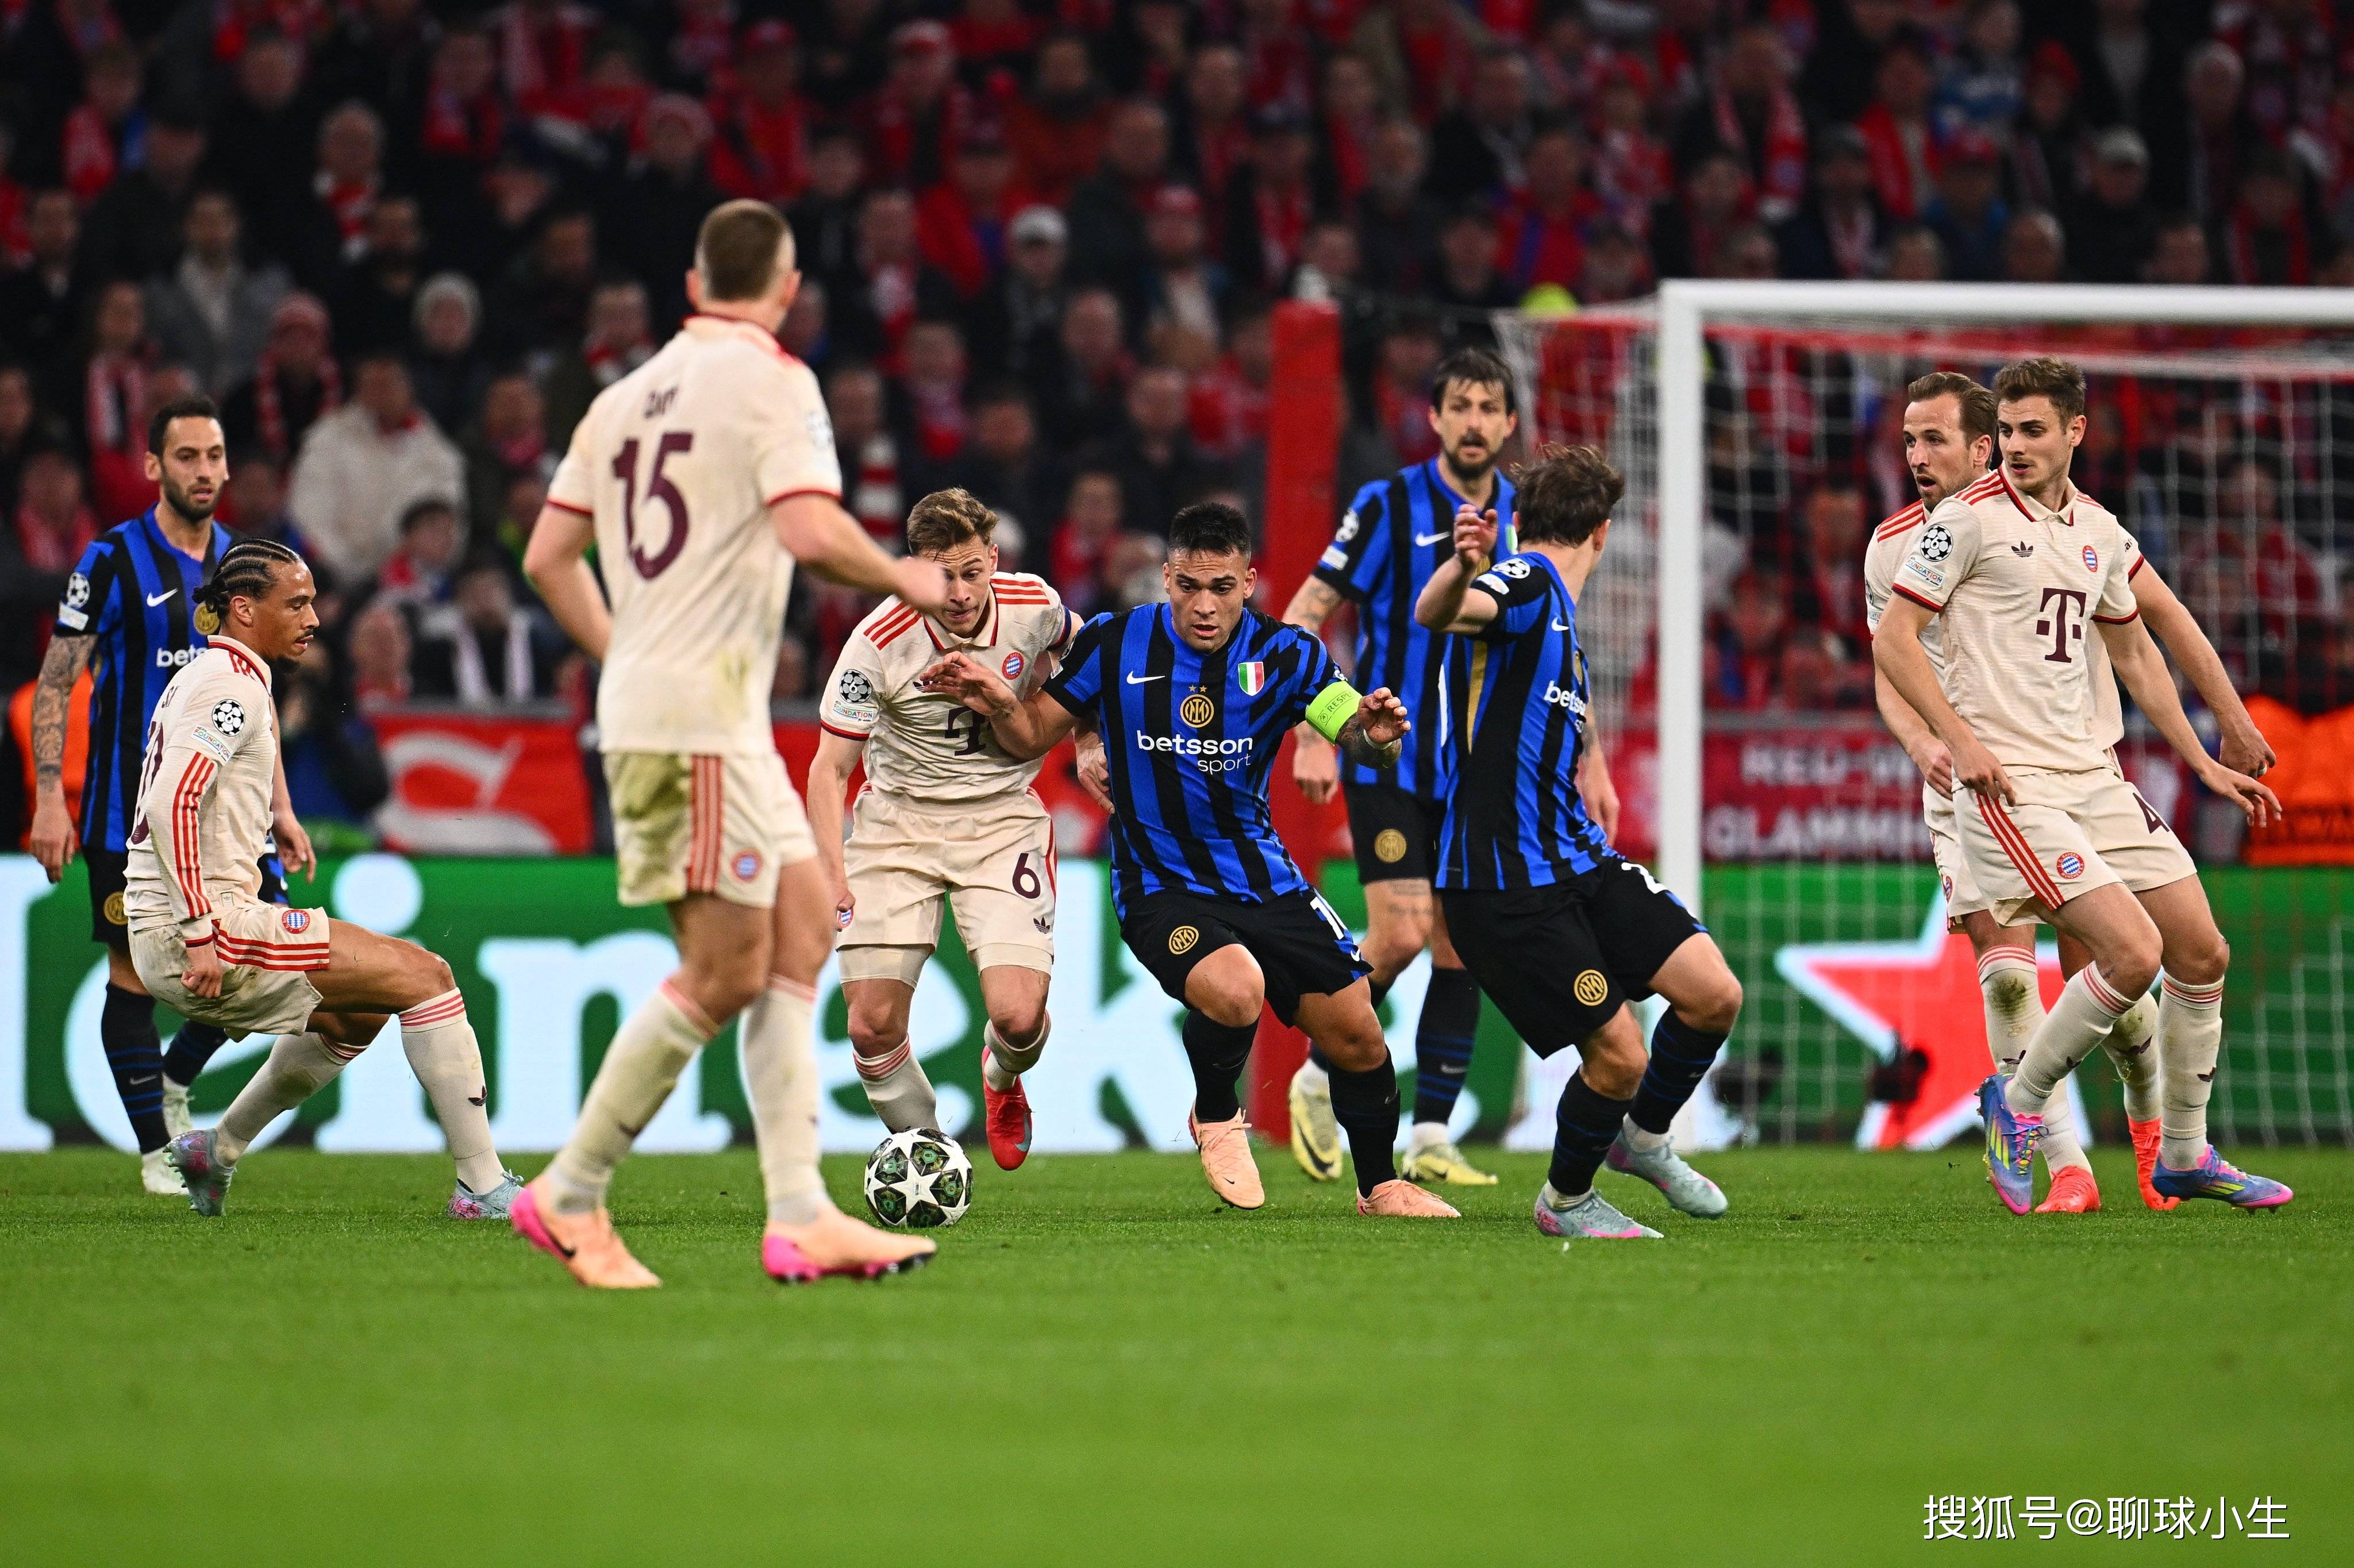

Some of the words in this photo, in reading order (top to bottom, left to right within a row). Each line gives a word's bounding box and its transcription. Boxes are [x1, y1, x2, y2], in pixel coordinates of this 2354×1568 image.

[612, 430, 694, 582] 15
[1137, 730, 1253, 755] betsson
[1197, 753, 1251, 775] sport
[2133, 792, 2170, 834] 4
[1012, 853, 1041, 899] 6
